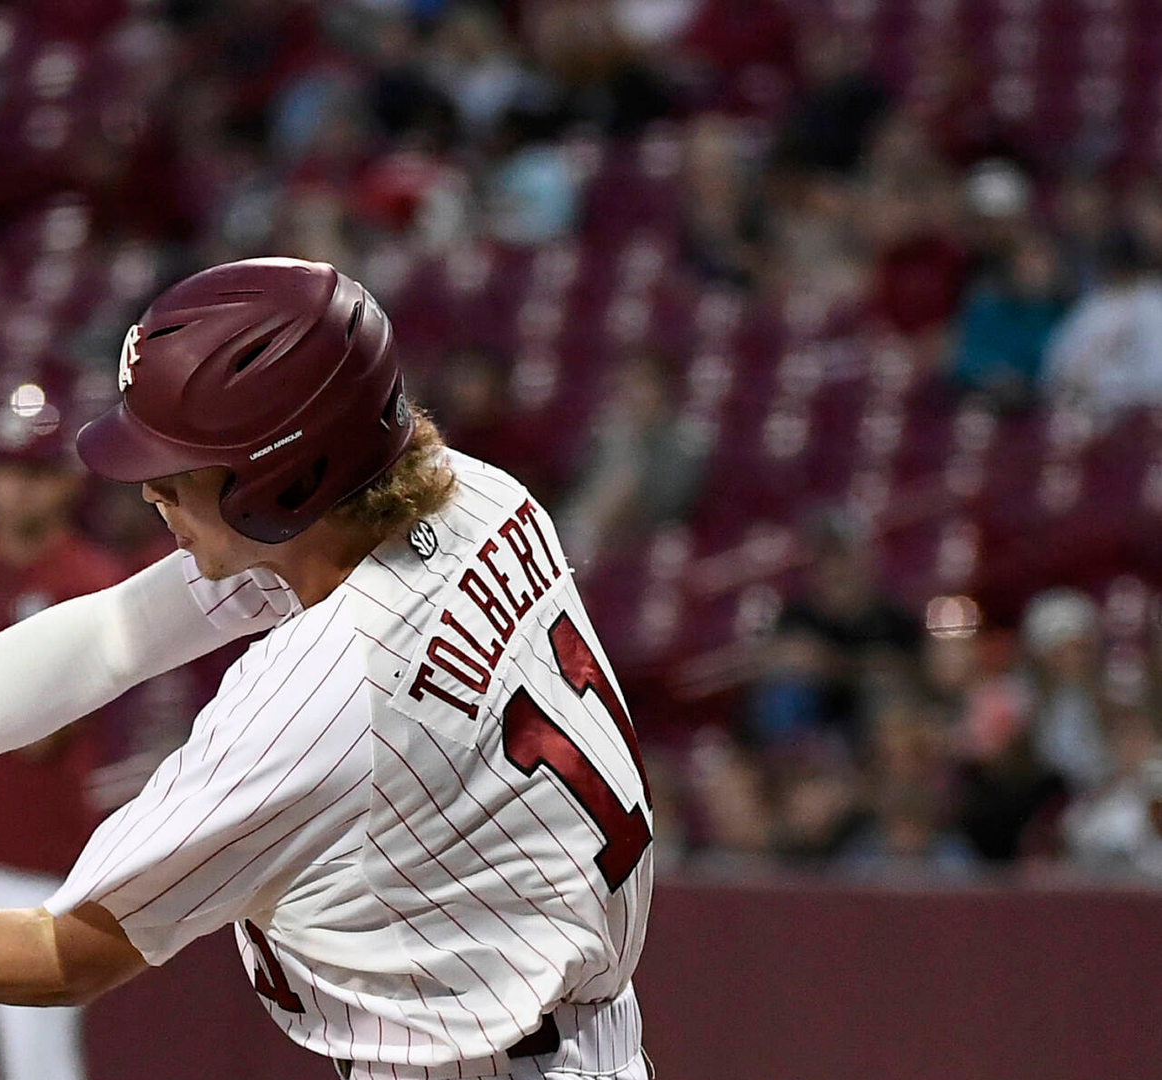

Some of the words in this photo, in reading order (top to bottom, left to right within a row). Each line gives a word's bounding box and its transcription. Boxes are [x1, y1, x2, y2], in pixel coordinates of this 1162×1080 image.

[250, 445, 273, 460] UNDER
[274, 430, 302, 449] ARMOUR
[408, 497, 562, 721] TOLBERT
[502, 609, 653, 895] 11
